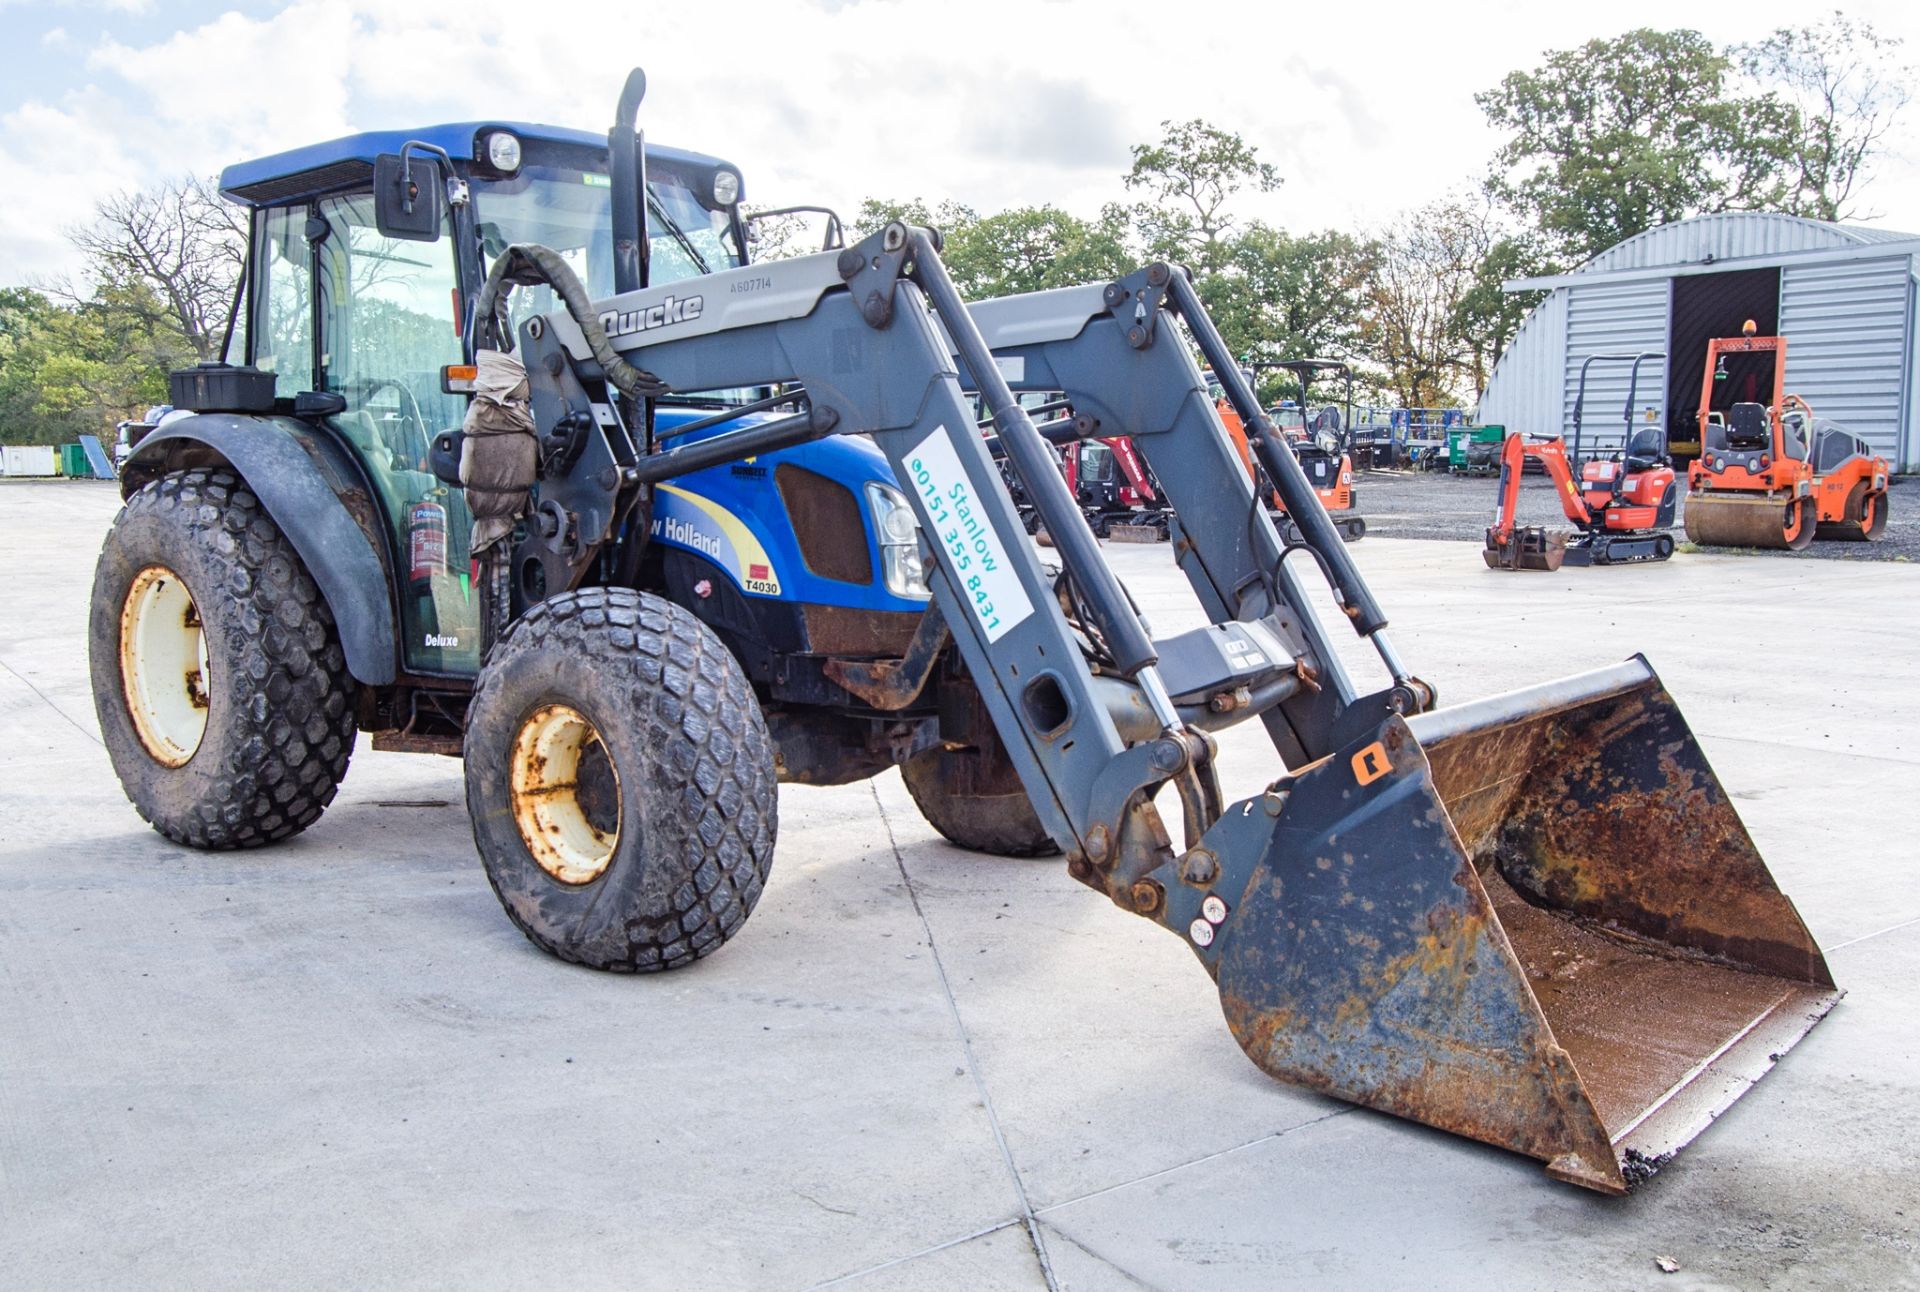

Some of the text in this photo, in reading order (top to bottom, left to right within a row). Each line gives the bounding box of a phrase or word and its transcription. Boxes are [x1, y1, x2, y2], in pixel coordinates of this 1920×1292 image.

[730, 276, 771, 293] A607714
[600, 295, 704, 338] Quicke
[665, 516, 720, 561] Holland
[948, 482, 997, 571] Stanlow
[917, 470, 1000, 630] 0151 355 8431
[746, 580, 778, 594] T4030
[425, 633, 458, 647] Deluxe
